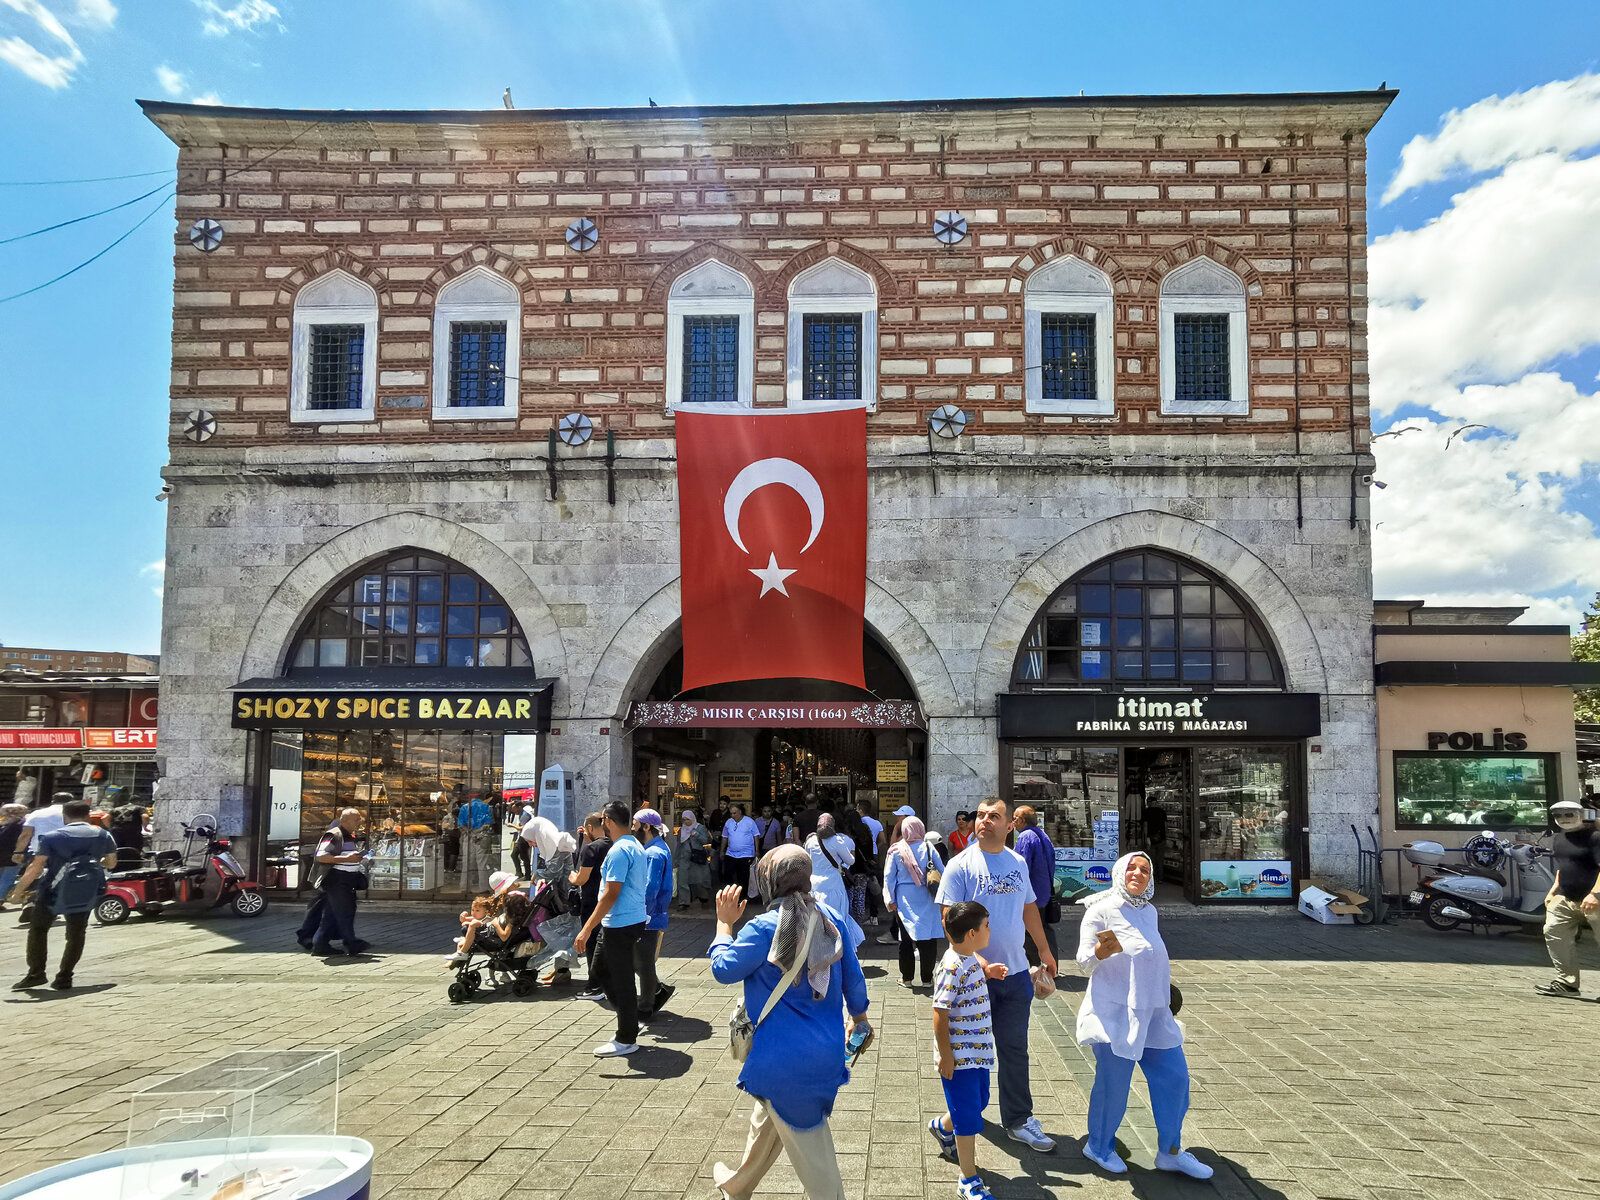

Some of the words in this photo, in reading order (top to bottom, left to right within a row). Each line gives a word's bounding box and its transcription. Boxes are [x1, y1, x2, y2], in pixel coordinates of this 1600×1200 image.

[238, 698, 330, 719] SHOZY
[336, 698, 410, 719] SPICE
[418, 698, 531, 719] BAZAAR
[702, 708, 744, 719] MISIR
[747, 708, 805, 721] ÇARŞISI
[808, 708, 847, 720] (1664)
[1118, 697, 1203, 717] itimat
[1076, 719, 1131, 731] FABRİKA
[1138, 721, 1175, 734] SATIŞ
[1182, 719, 1248, 731] MAĞAZASI
[18, 733, 76, 744] TOHUMCULUK
[1427, 728, 1528, 751] POLİS
[979, 873, 1000, 883] STAY
